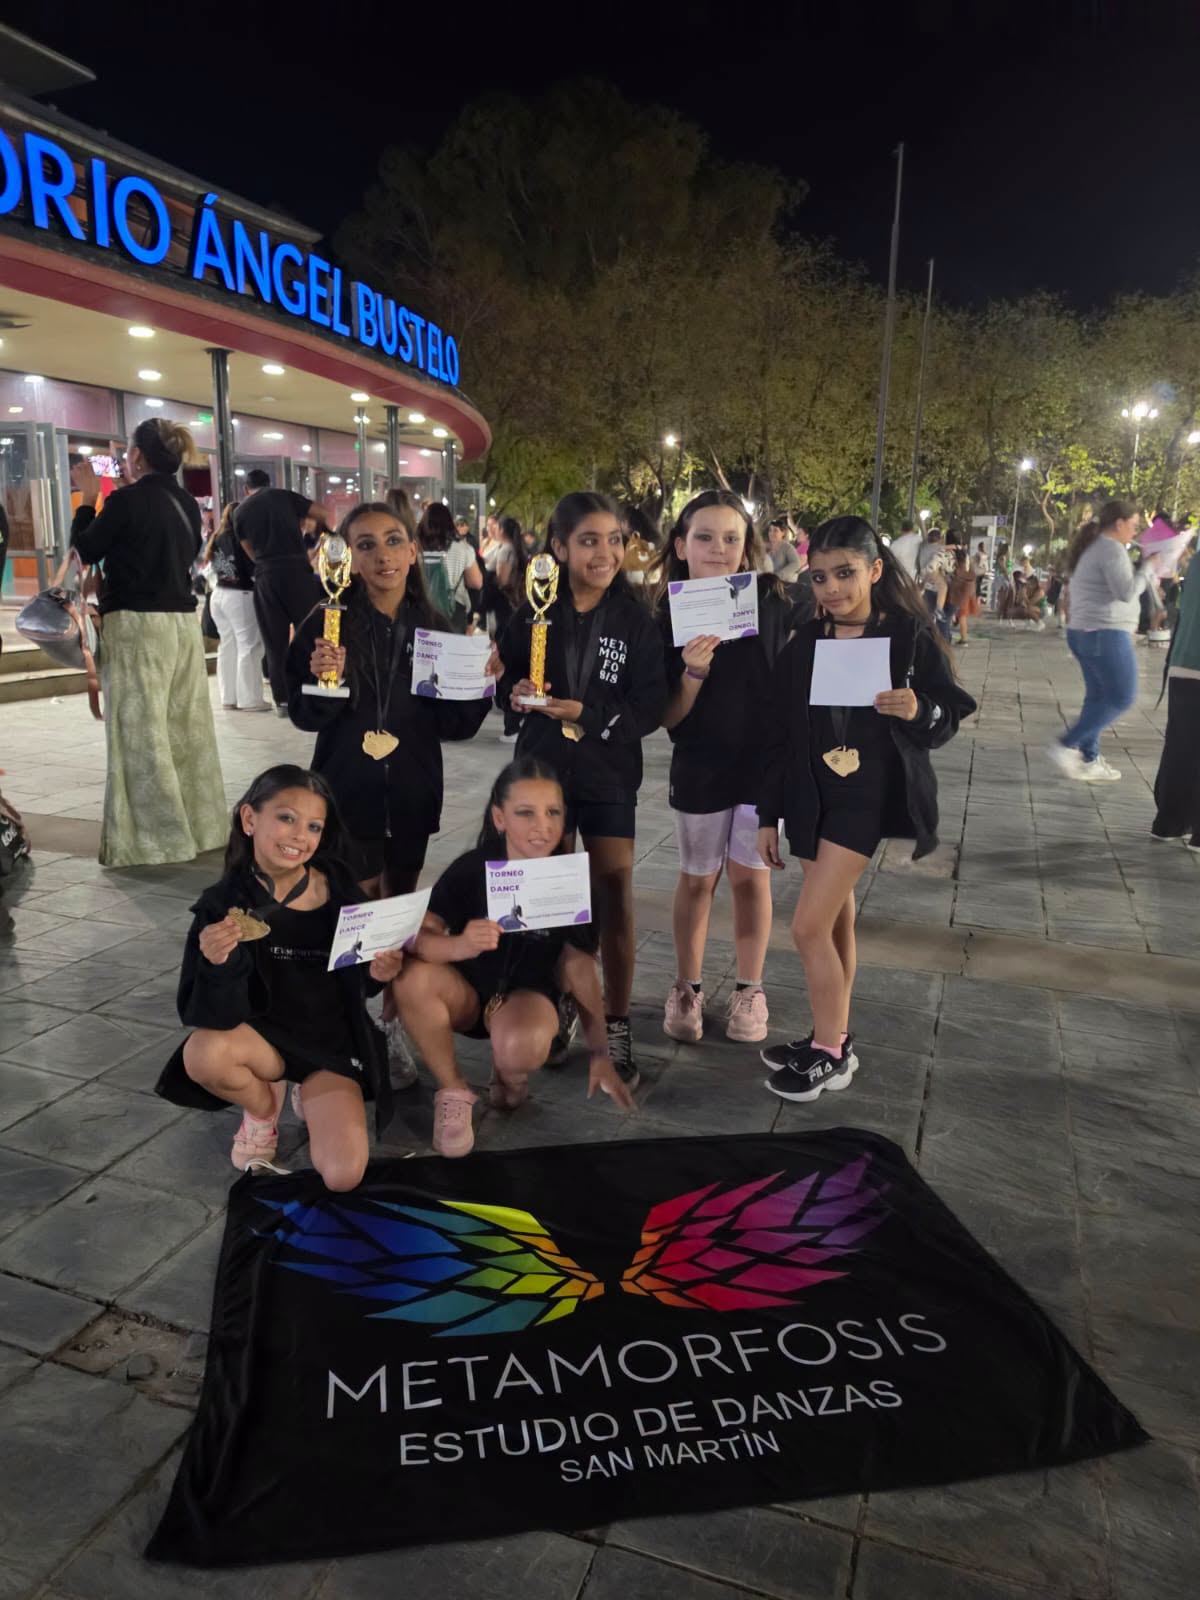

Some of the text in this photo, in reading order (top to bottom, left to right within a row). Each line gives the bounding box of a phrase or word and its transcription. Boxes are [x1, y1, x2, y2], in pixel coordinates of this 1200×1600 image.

[193, 192, 351, 337] ÁNGEL
[355, 281, 460, 387] BUSTELO
[598, 646, 627, 665] MOR
[602, 658, 619, 673] FO
[599, 669, 618, 684] SIS
[490, 869, 525, 879] TORNEO
[490, 884, 520, 893] DANCE
[808, 1061, 833, 1083] FILA
[326, 1313, 948, 1420] METAMORFOSIS
[400, 1379, 903, 1466] ESTUDIO DE DANZAS
[559, 1446, 635, 1483] SAN
